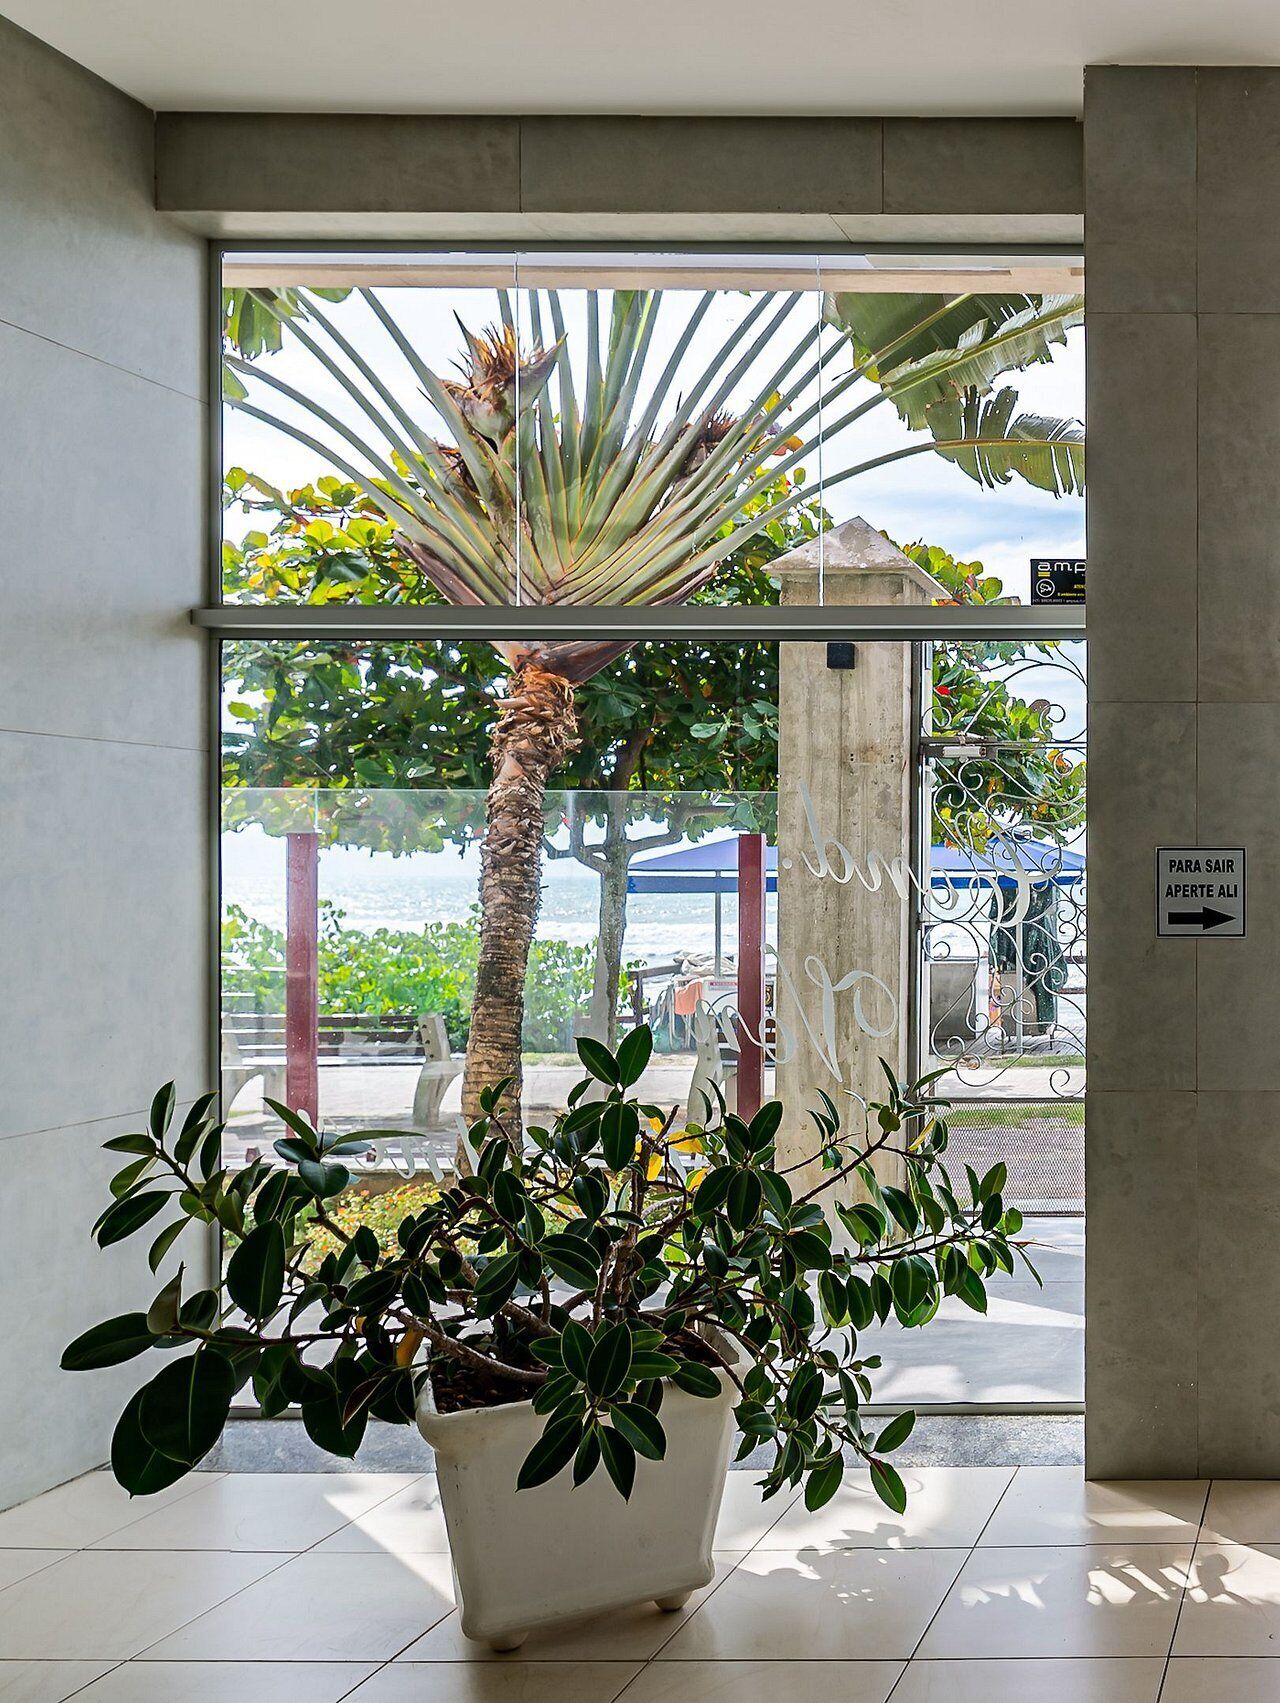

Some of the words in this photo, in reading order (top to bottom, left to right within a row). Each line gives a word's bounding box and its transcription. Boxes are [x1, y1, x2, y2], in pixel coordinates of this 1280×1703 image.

[1168, 859, 1202, 873] PARA
[1205, 858, 1235, 873] SAIR
[1165, 884, 1214, 898] APERTE
[1217, 884, 1238, 898] ALI
